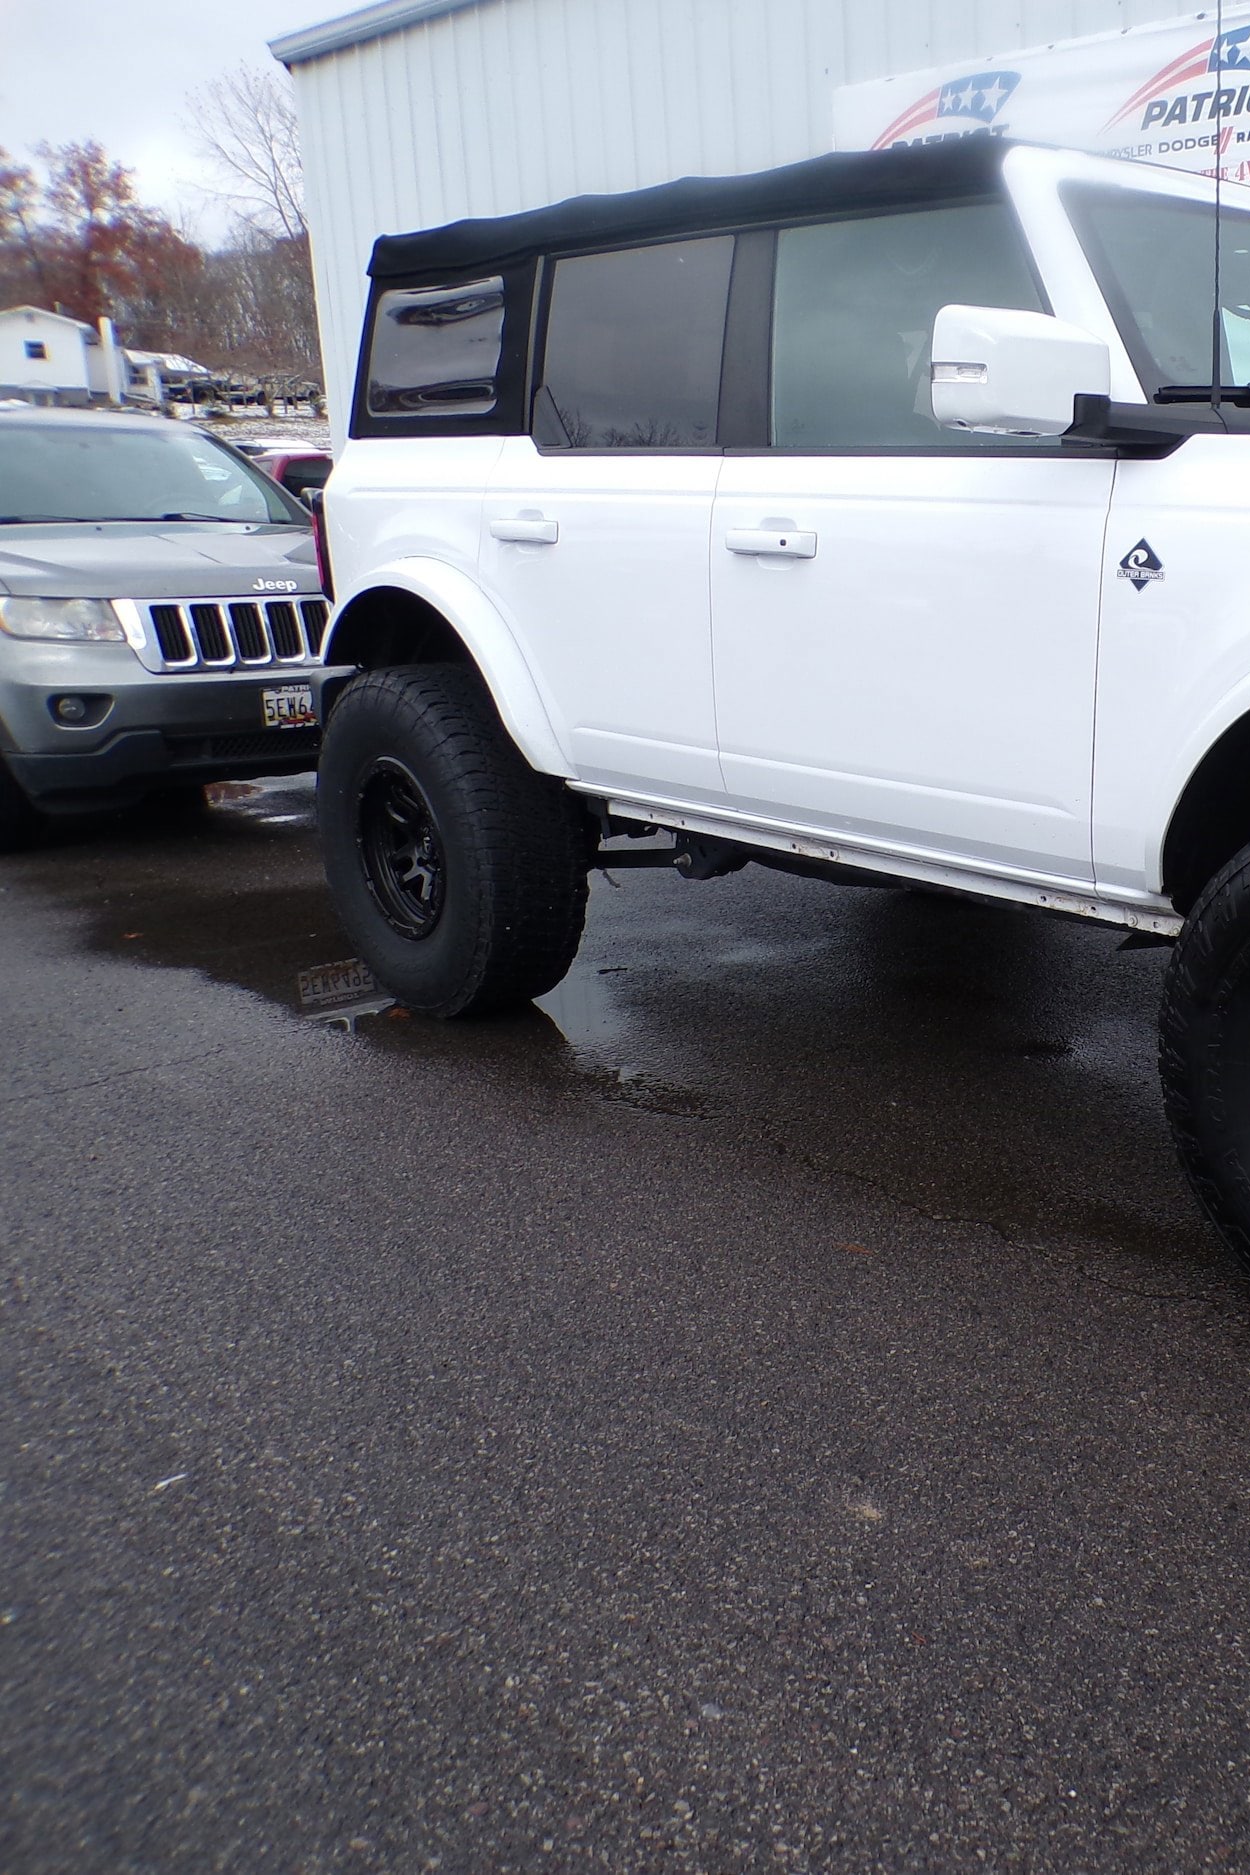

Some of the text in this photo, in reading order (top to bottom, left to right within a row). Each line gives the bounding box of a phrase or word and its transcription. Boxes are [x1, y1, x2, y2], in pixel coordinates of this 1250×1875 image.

[1158, 134, 1220, 154] DODGE
[1118, 569, 1163, 580] OUTER BANKS
[252, 578, 298, 593] Jeep
[281, 684, 311, 694] PATRI
